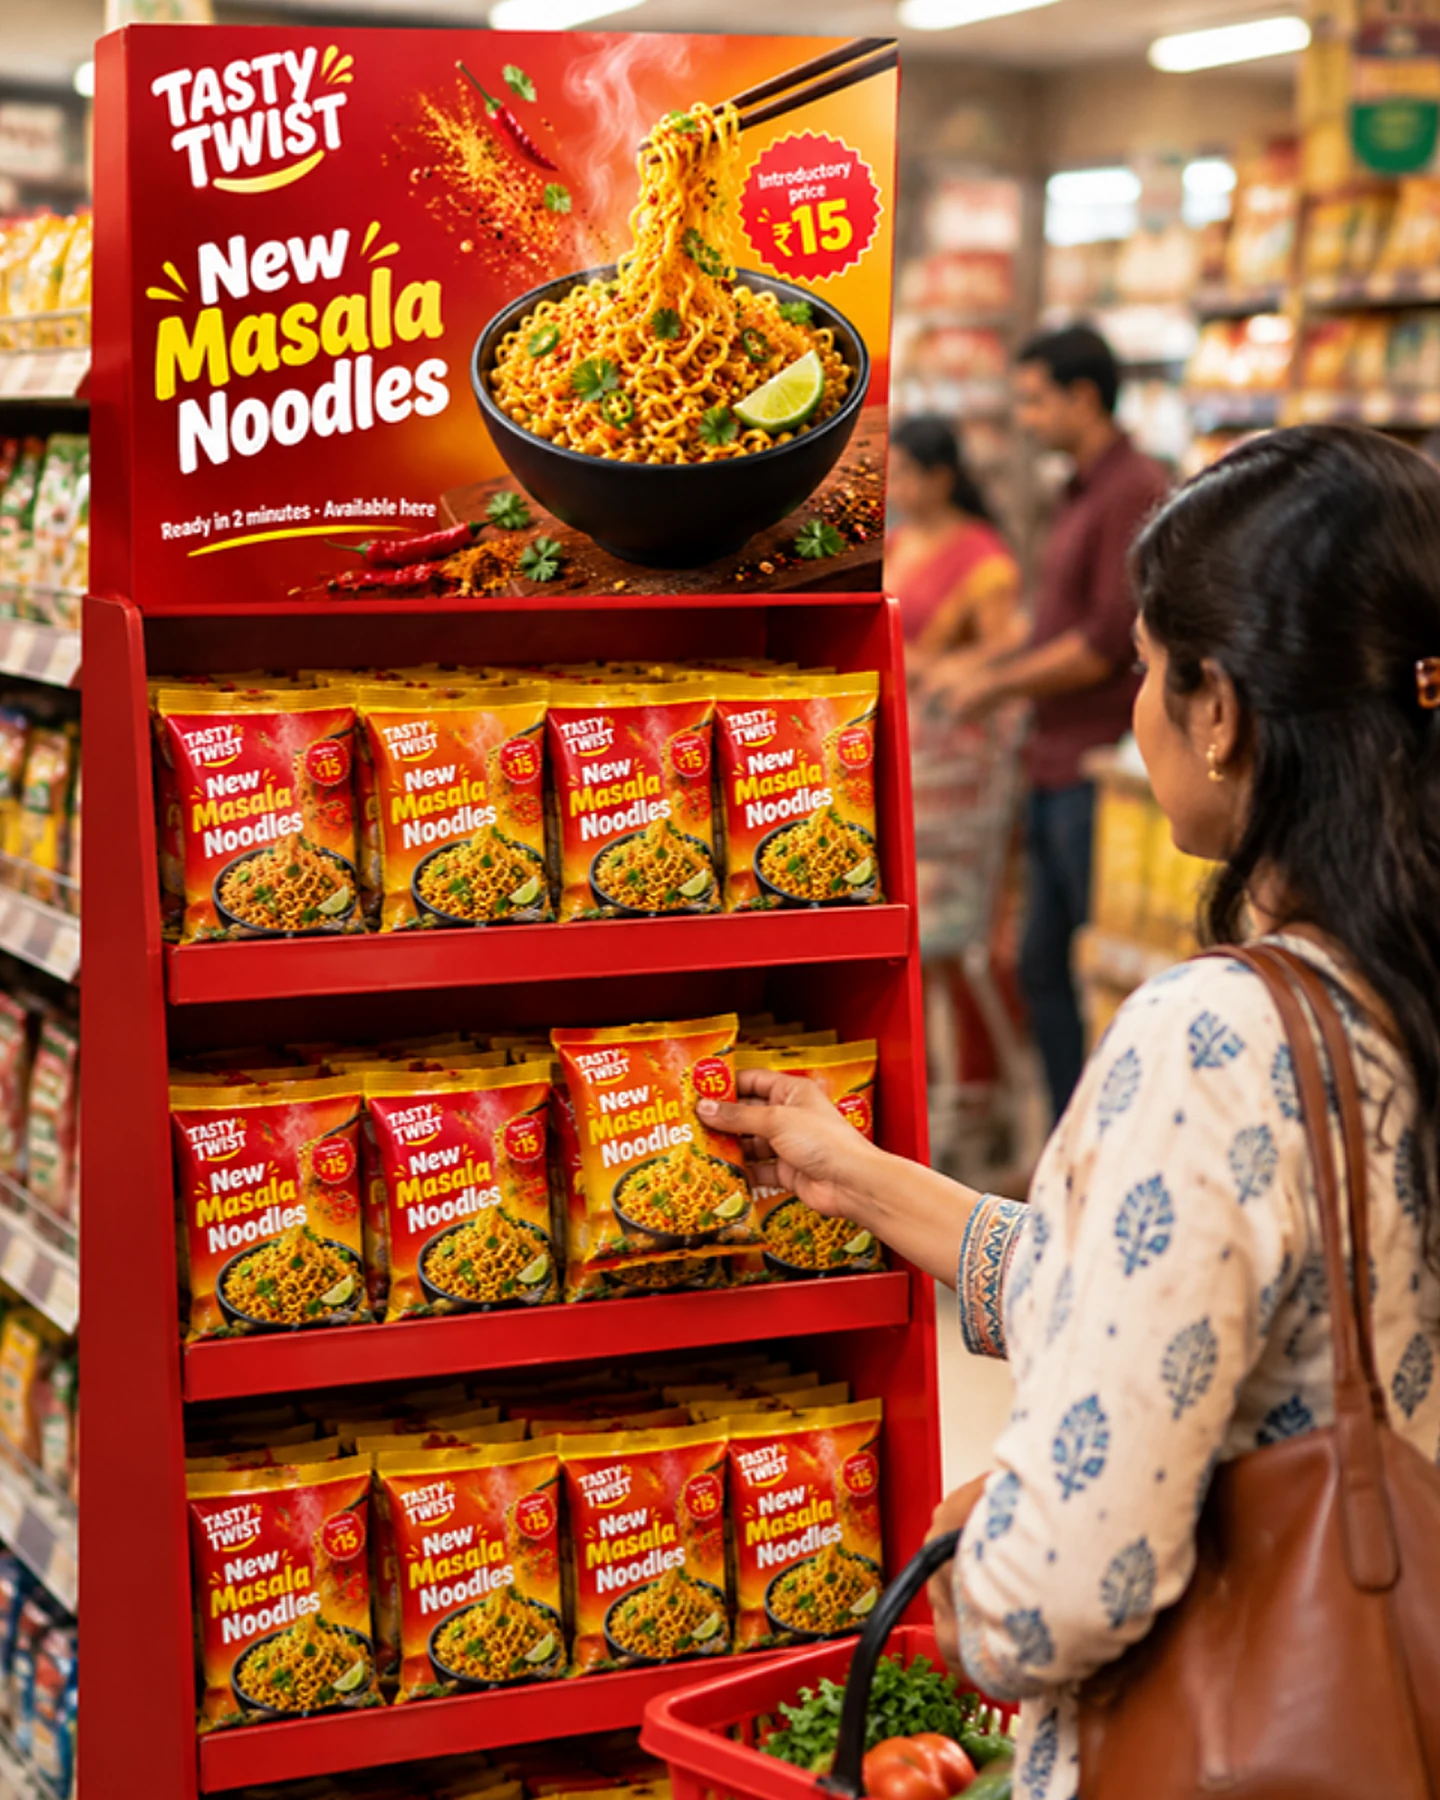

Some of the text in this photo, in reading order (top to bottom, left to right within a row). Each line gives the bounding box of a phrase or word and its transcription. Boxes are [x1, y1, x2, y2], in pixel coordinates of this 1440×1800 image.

[151, 47, 318, 127] TASTY
[171, 92, 347, 188] TWIST
[758, 162, 852, 189] Introductory
[788, 184, 826, 205] price
[198, 228, 350, 305] New
[155, 266, 443, 401] Masala
[178, 354, 450, 475] Noodles
[161, 516, 211, 539] Ready
[214, 512, 230, 530] in
[232, 509, 244, 528] 2
[246, 504, 311, 525] minutes
[323, 498, 397, 517] Available
[400, 498, 436, 517] here
[383, 720, 428, 745] TASTY
[560, 716, 604, 738] TASTY
[726, 709, 768, 729] TASTY
[731, 720, 777, 745] TWIST
[183, 724, 233, 749] TASTY
[189, 737, 242, 766] TWIST
[388, 733, 438, 761] TWIST
[566, 728, 614, 755] TWIST
[404, 764, 456, 792] New
[582, 758, 631, 785] New
[747, 749, 794, 775] New
[206, 770, 260, 798] New
[569, 771, 661, 817] Masala
[735, 761, 823, 805] Masala
[192, 783, 293, 833] Masala
[391, 777, 487, 825] Masala
[745, 787, 834, 829] Noodles
[203, 812, 304, 858] Noodles
[402, 805, 497, 849] Noodles
[581, 799, 672, 841] Noodles
[576, 1048, 620, 1069] TASTY
[581, 1057, 630, 1085] TWIST
[598, 1084, 649, 1113] New
[187, 1117, 235, 1142] TASTY
[387, 1103, 433, 1127] TASTY
[392, 1115, 443, 1145] TWIST
[588, 1095, 680, 1145] Masala
[191, 1130, 246, 1161] TWIST
[409, 1144, 460, 1175] New
[601, 1122, 694, 1168] Noodles
[209, 1162, 265, 1193] New
[396, 1157, 492, 1208] Masala
[195, 1176, 296, 1228] Masala
[407, 1185, 502, 1234] Noodles
[207, 1204, 307, 1254] Noodles
[737, 1444, 778, 1469] TASTY
[742, 1455, 788, 1487] TWIST
[578, 1464, 622, 1490] TASTY
[583, 1476, 632, 1508] TWIST
[400, 1481, 446, 1508] TASTY
[405, 1493, 455, 1525] TWIST
[757, 1485, 805, 1516] New
[201, 1504, 251, 1532] TASTY
[207, 1516, 262, 1552] TWIST
[599, 1508, 647, 1538] New
[745, 1497, 834, 1546] Masala
[422, 1525, 474, 1557] New
[586, 1520, 676, 1569] Masala
[756, 1522, 843, 1569] Noodles
[224, 1550, 279, 1584] New
[409, 1538, 505, 1590] Masala
[596, 1546, 686, 1594] Noodles
[210, 1564, 310, 1618] Masala
[420, 1564, 514, 1615] Noodles
[221, 1591, 321, 1645] Noodles
